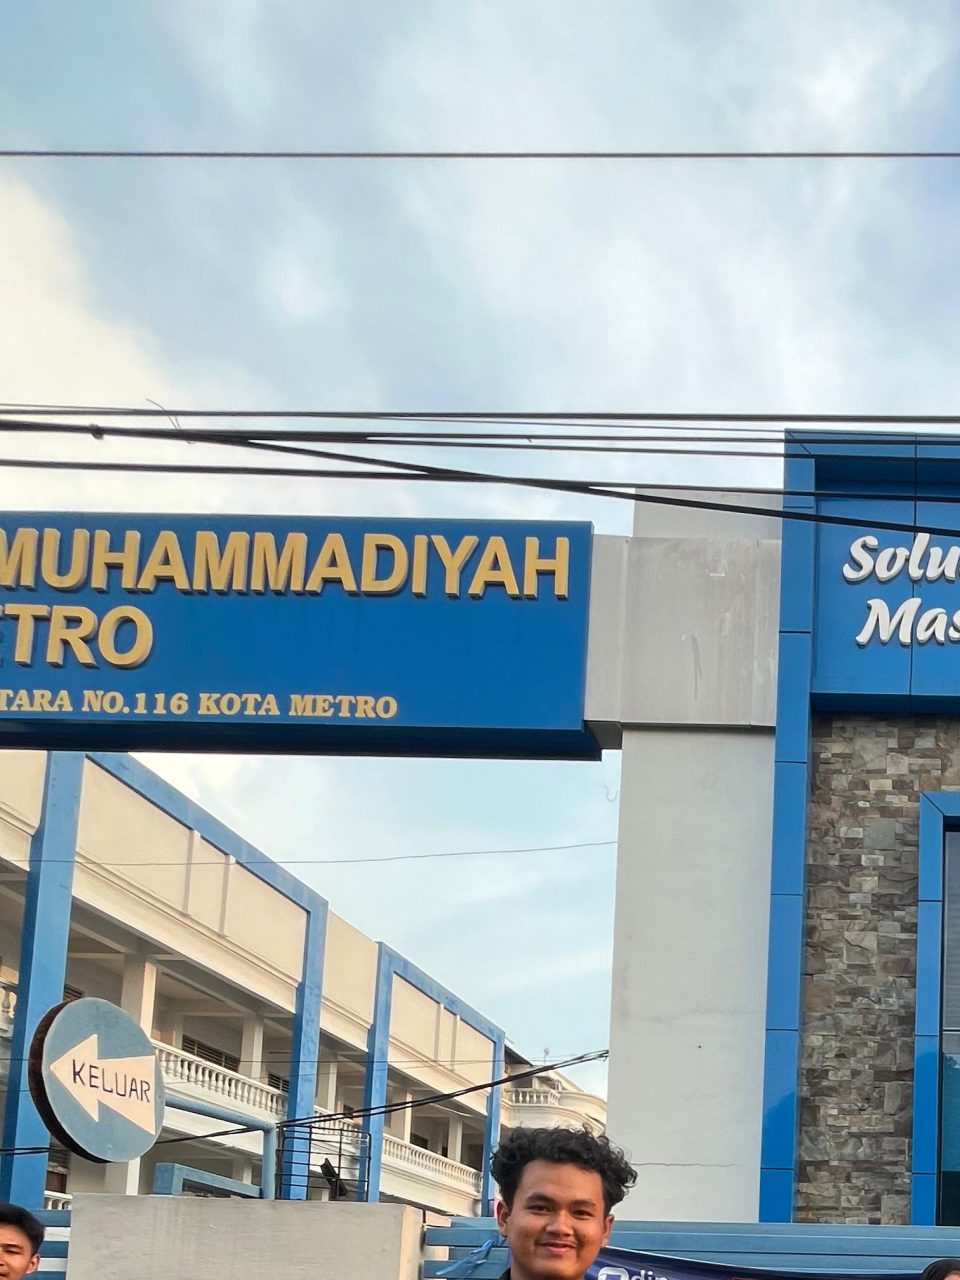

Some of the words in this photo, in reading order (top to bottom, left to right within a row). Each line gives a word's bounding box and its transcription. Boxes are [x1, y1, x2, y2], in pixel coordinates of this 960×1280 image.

[0, 527, 570, 599] MUHAMMADIYAH
[0, 603, 154, 669] TRO
[82, 690, 189, 715] NO.116
[198, 693, 281, 716] KOTA
[289, 694, 398, 719] METRO
[72, 1059, 151, 1103] KELUAR
